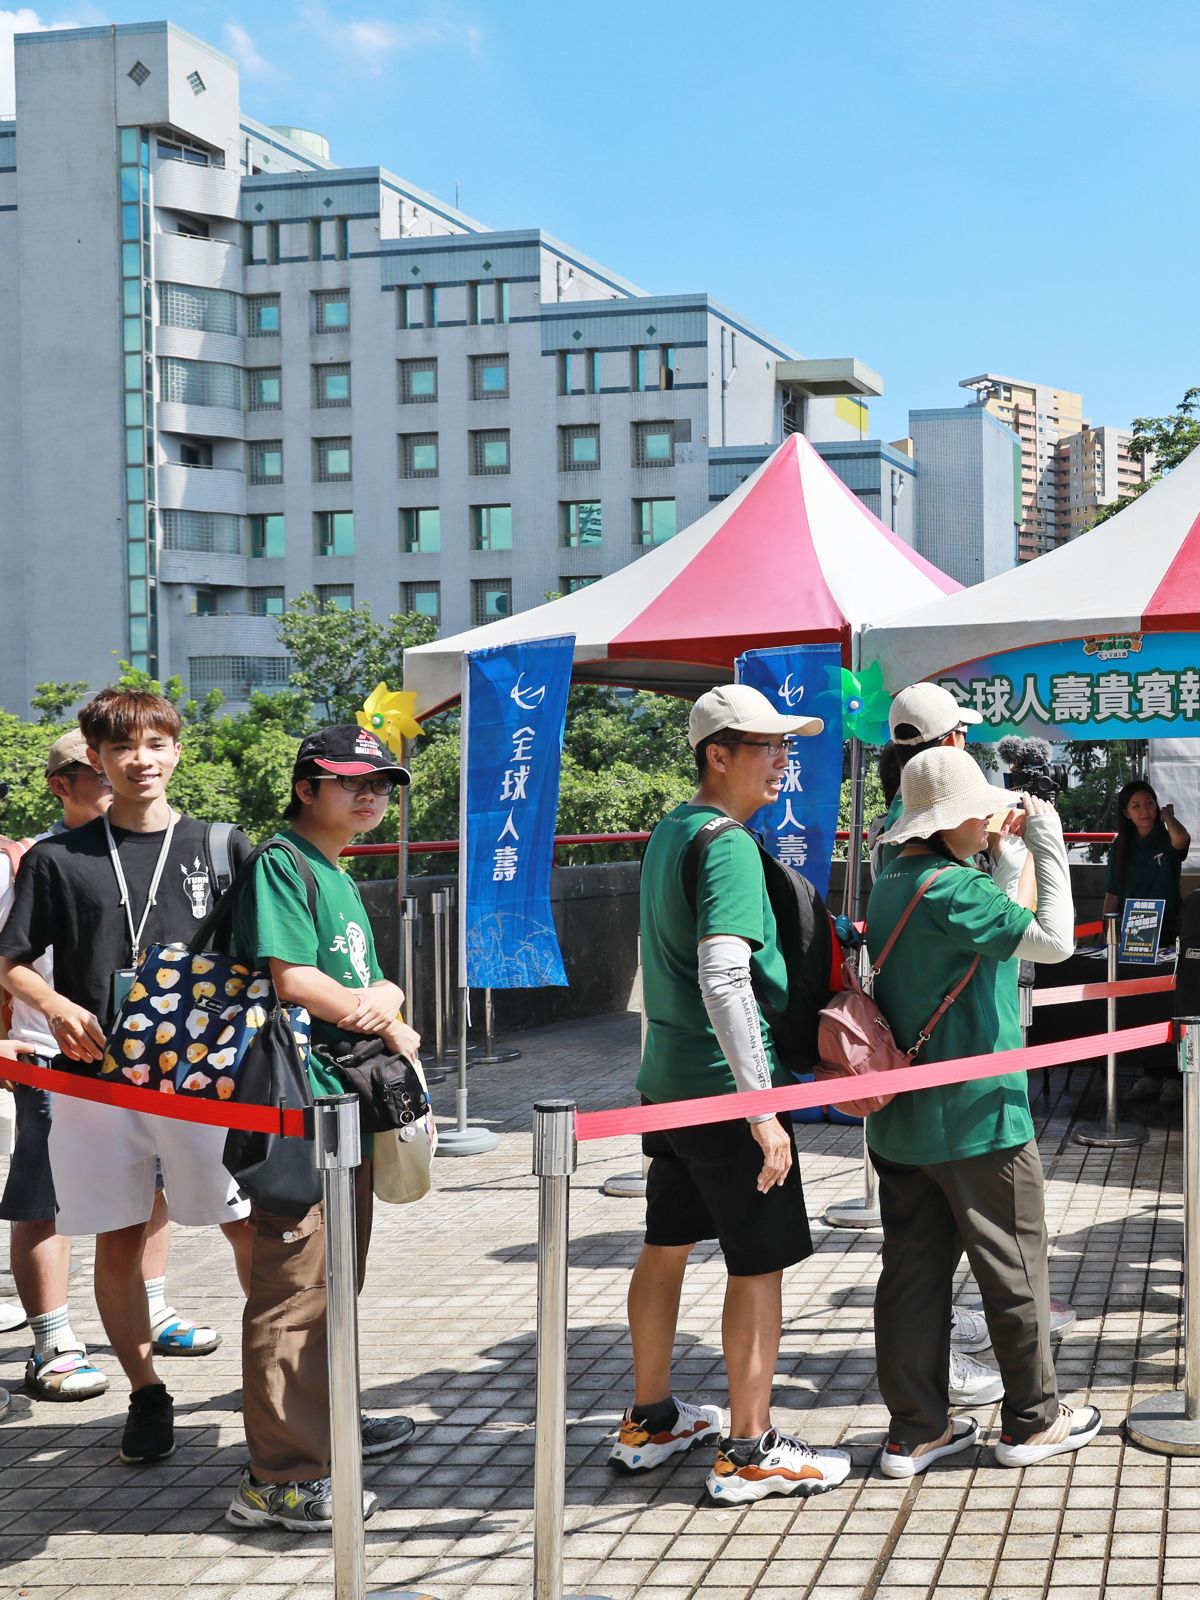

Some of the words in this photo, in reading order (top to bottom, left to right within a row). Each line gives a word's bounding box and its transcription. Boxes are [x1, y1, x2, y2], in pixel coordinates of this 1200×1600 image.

[492, 726, 536, 882] 全球人壽
[186, 876, 209, 885] TURN
[740, 996, 757, 1049] AMERICAN
[752, 1053, 767, 1089] SPORTS
